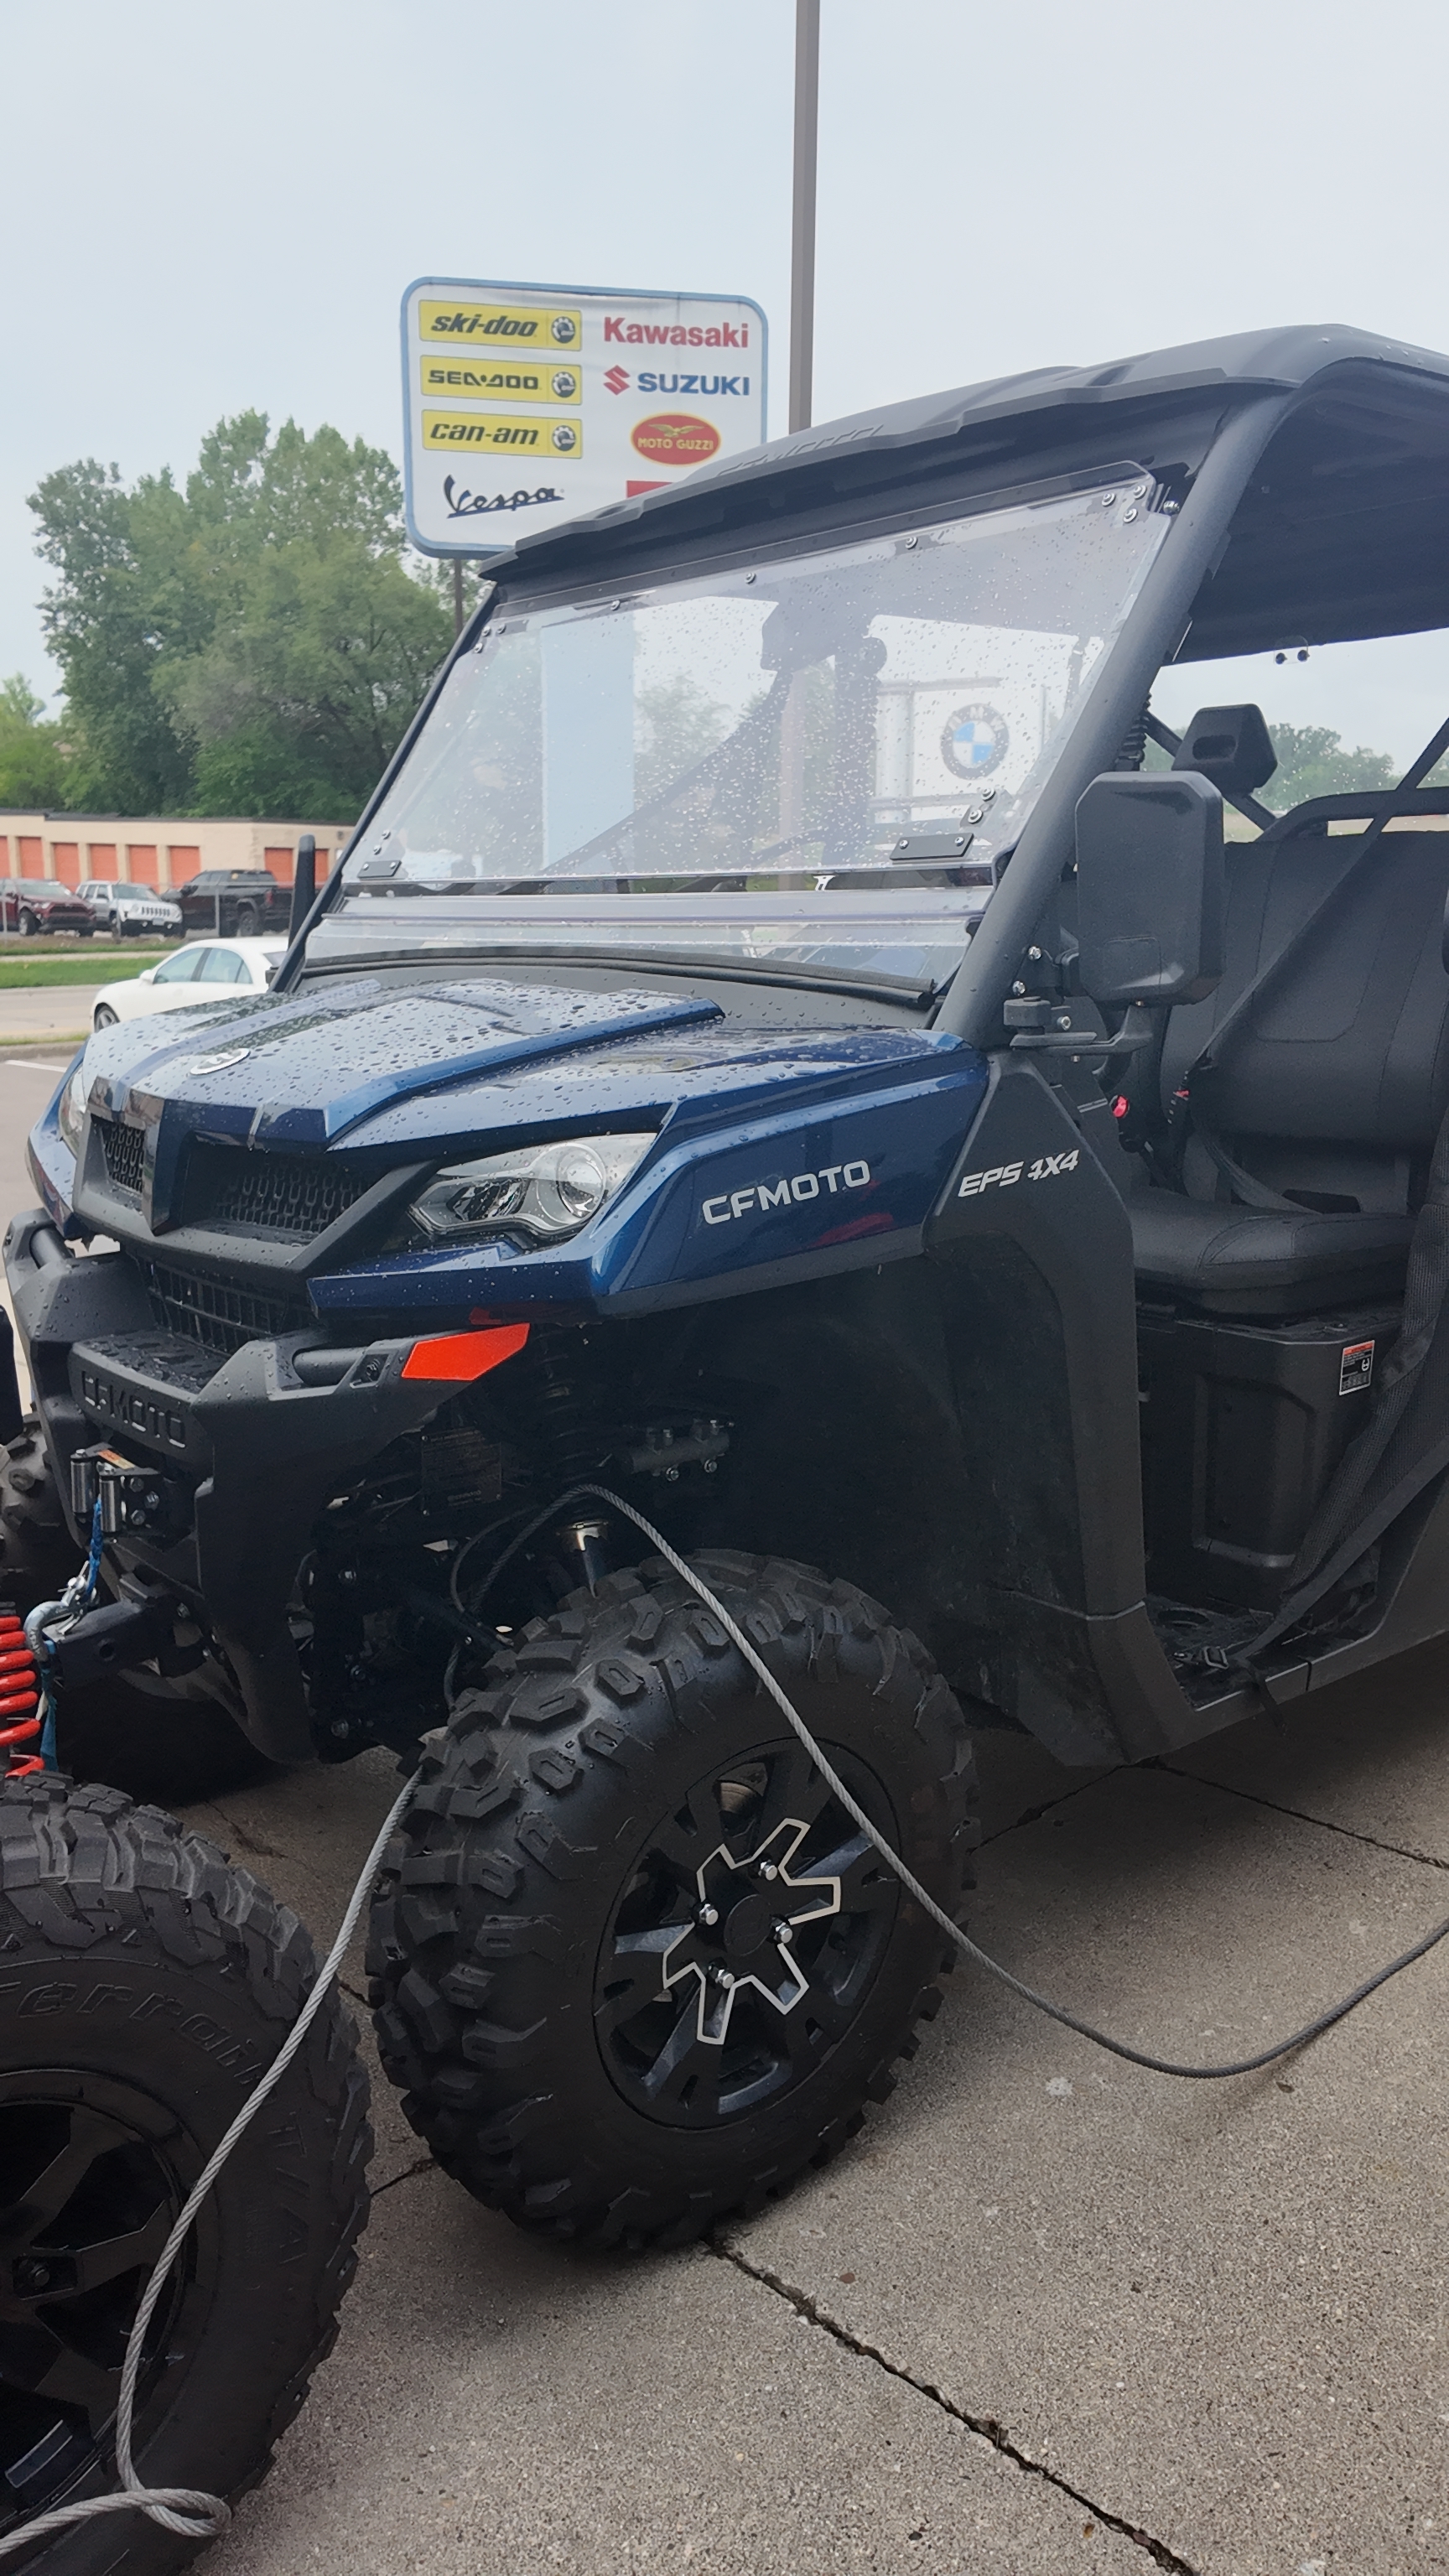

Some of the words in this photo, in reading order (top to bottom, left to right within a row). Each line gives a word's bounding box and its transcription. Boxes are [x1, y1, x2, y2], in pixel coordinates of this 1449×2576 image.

[430, 312, 539, 337] ski-doo
[604, 316, 749, 348] Kawasaki
[637, 372, 750, 396] SUZUKI
[430, 423, 539, 445] can-am
[637, 437, 673, 449] MOTO
[676, 439, 714, 451] GUZZI
[443, 474, 565, 519] Vespa
[701, 1159, 872, 1225] CFMOTO
[957, 1161, 1025, 1198] EPS
[0, 1980, 265, 2085] errai
